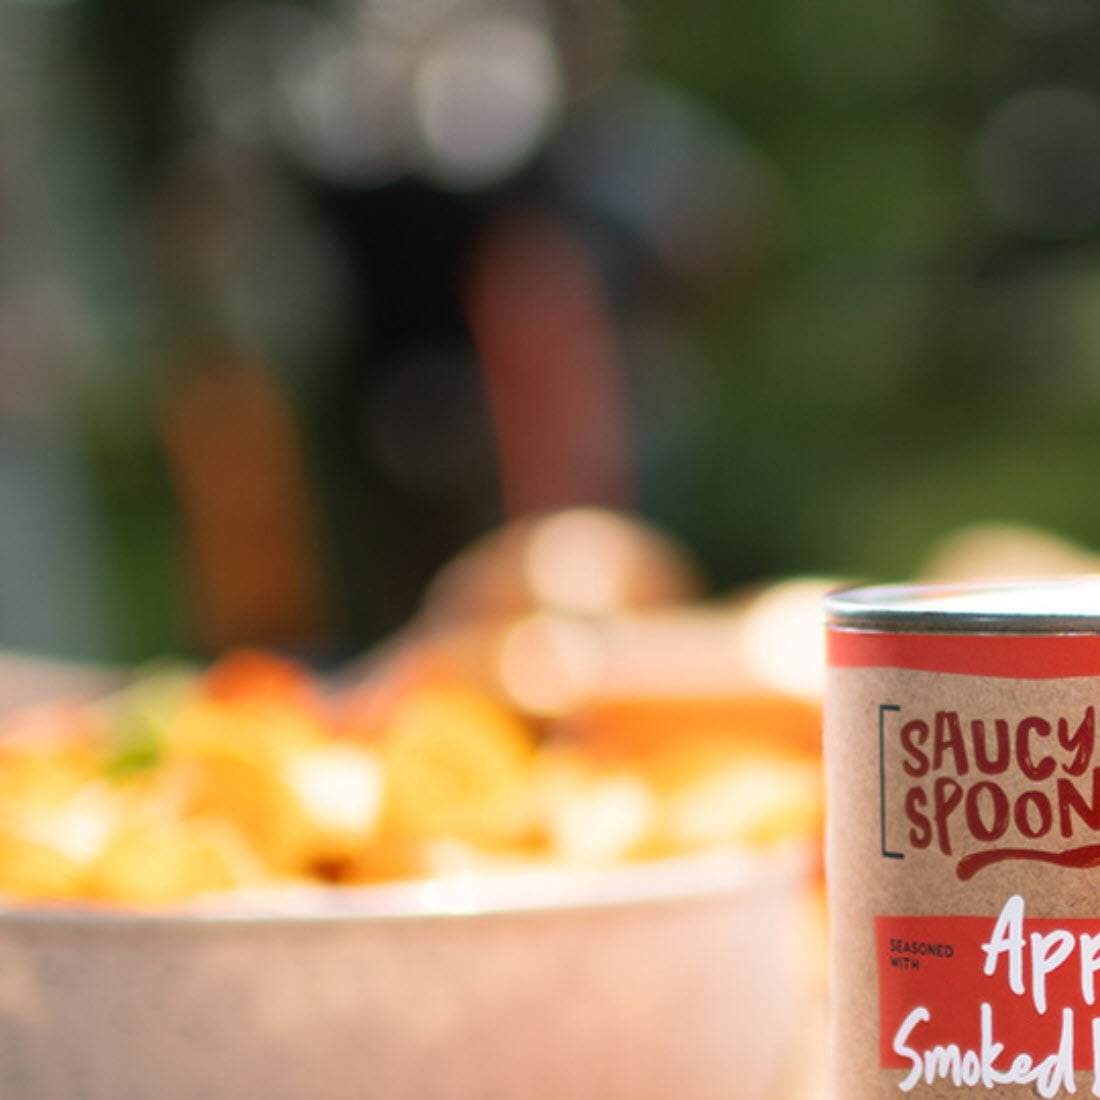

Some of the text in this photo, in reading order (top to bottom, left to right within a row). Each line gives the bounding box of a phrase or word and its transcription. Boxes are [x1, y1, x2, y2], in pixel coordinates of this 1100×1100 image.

[900, 706, 1096, 781] SAUCY
[890, 939, 954, 958] SEASONED
[891, 957, 919, 970] WITH
[892, 1003, 1077, 1098] Smoked
